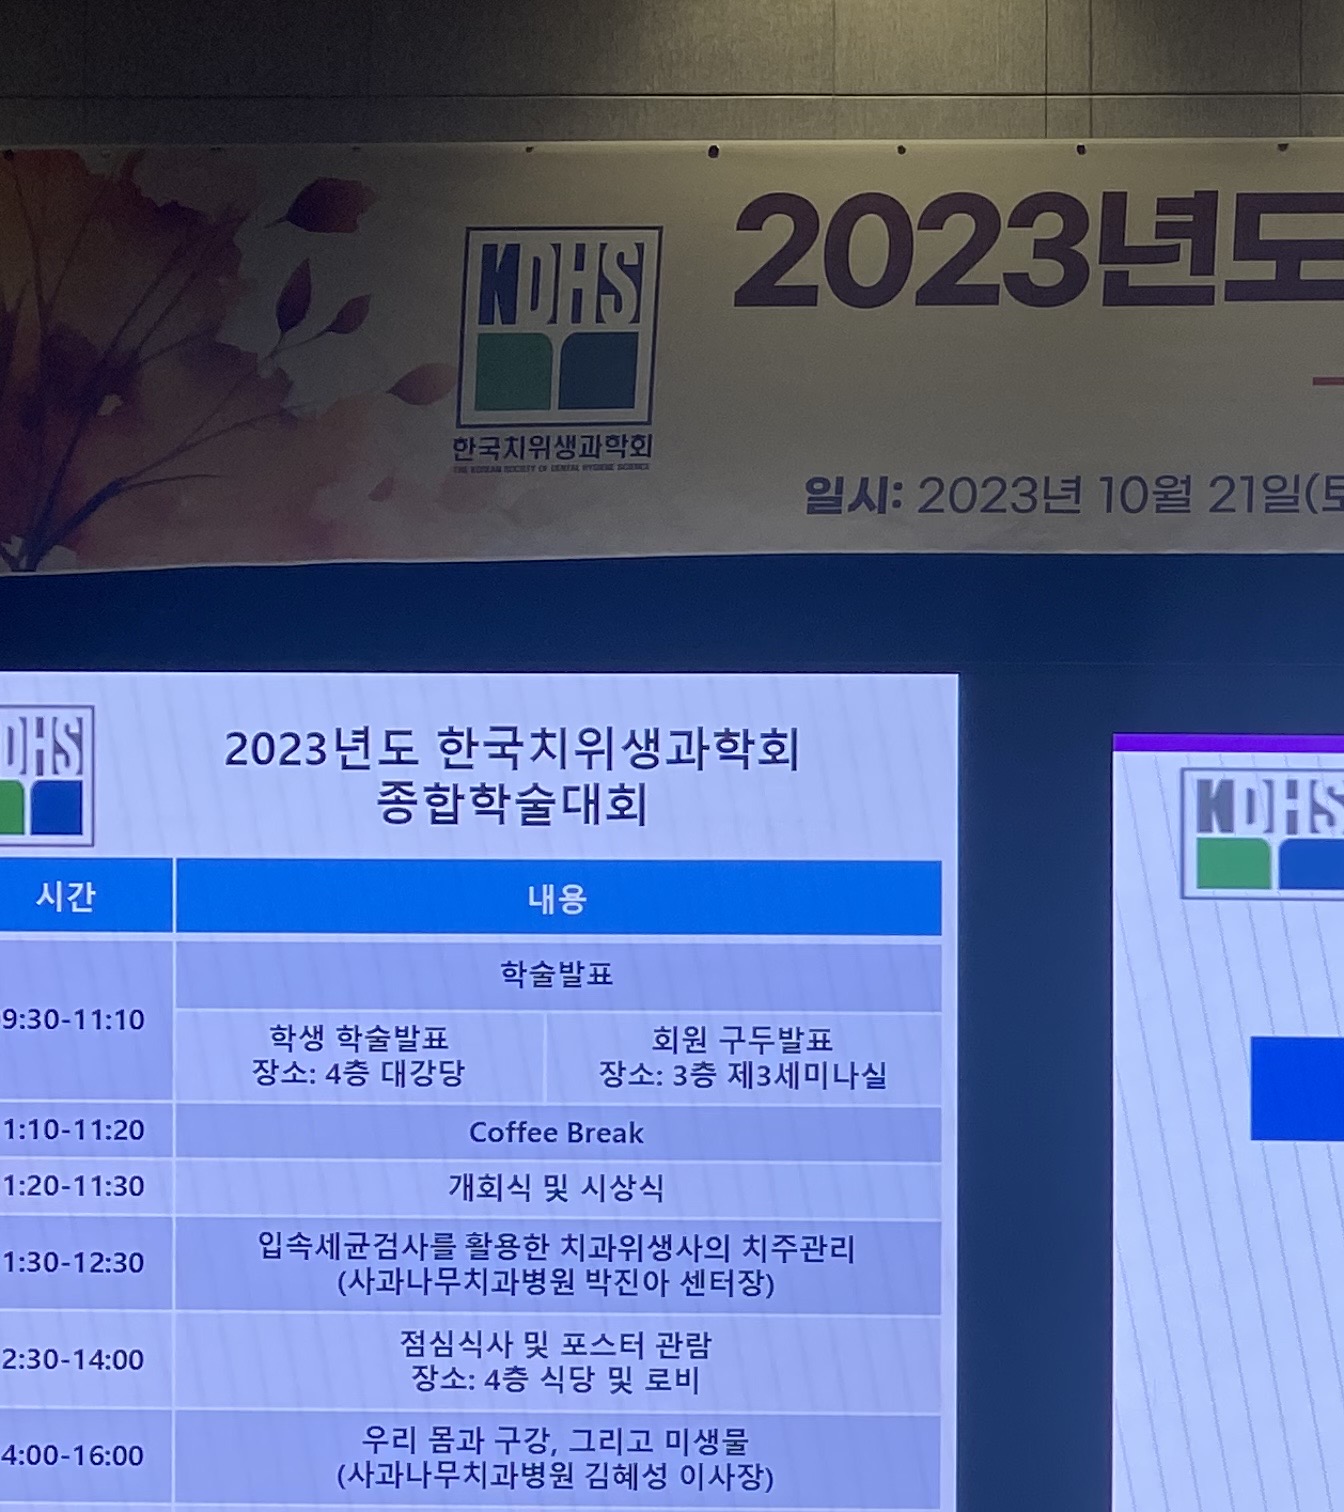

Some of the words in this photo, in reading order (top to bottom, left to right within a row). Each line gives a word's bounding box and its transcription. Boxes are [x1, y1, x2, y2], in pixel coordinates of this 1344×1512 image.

[478, 242, 645, 325] KDHS
[453, 434, 652, 461] 한국치위생과학회
[806, 476, 902, 514] 일시:
[918, 476, 1081, 514] 2023년
[1100, 475, 1191, 513] 10월
[226, 726, 418, 770] 2023년도
[438, 726, 797, 771] 한국치위생과학회
[378, 781, 644, 826] 종합학술대회
[36, 881, 96, 912] 시간
[529, 885, 586, 914] 내용
[501, 961, 613, 988] 학술발표
[270, 1025, 323, 1052] 학생
[337, 1025, 448, 1053] 학술발표
[652, 1026, 706, 1054] 회원
[720, 1027, 832, 1055] 구두발표
[253, 1059, 315, 1086] 장소:
[326, 1060, 369, 1086] 4층
[382, 1060, 465, 1088] 대강당
[600, 1061, 662, 1087] 장소:
[674, 1062, 716, 1088] 3층
[728, 1061, 886, 1090] 제3세미나실
[470, 1121, 557, 1142] Coffee
[568, 1122, 643, 1143] Break
[450, 1174, 529, 1202] 개회식
[545, 1174, 568, 1202] 및
[582, 1174, 662, 1202] 시상식
[260, 1232, 456, 1261] 입속세균검사를
[466, 1232, 550, 1260] 활용한
[561, 1234, 729, 1263] 치과위생사의
[743, 1235, 853, 1263] 치주관리
[339, 1267, 574, 1296] (사과나무치과병원
[587, 1269, 669, 1297] 박진아
[680, 1269, 774, 1298] 센터장)
[401, 1330, 513, 1359] 점심식사
[525, 1331, 548, 1358] 및
[561, 1332, 643, 1360] 포스터
[656, 1332, 712, 1359] 관람
[413, 1365, 474, 1391] 장소:
[485, 1366, 528, 1392] 4층
[541, 1366, 595, 1393] 식당
[609, 1367, 632, 1394] 및
[645, 1367, 698, 1394] 로비
[363, 1426, 415, 1454] 우리
[429, 1427, 484, 1454] 몸과
[495, 1427, 556, 1456] 구강,
[569, 1428, 653, 1456] 그리고
[667, 1429, 748, 1456] 미생물
[338, 1461, 573, 1489] (사과나무치과병원
[586, 1463, 666, 1491] 김혜성
[681, 1463, 773, 1493] 이사장)
